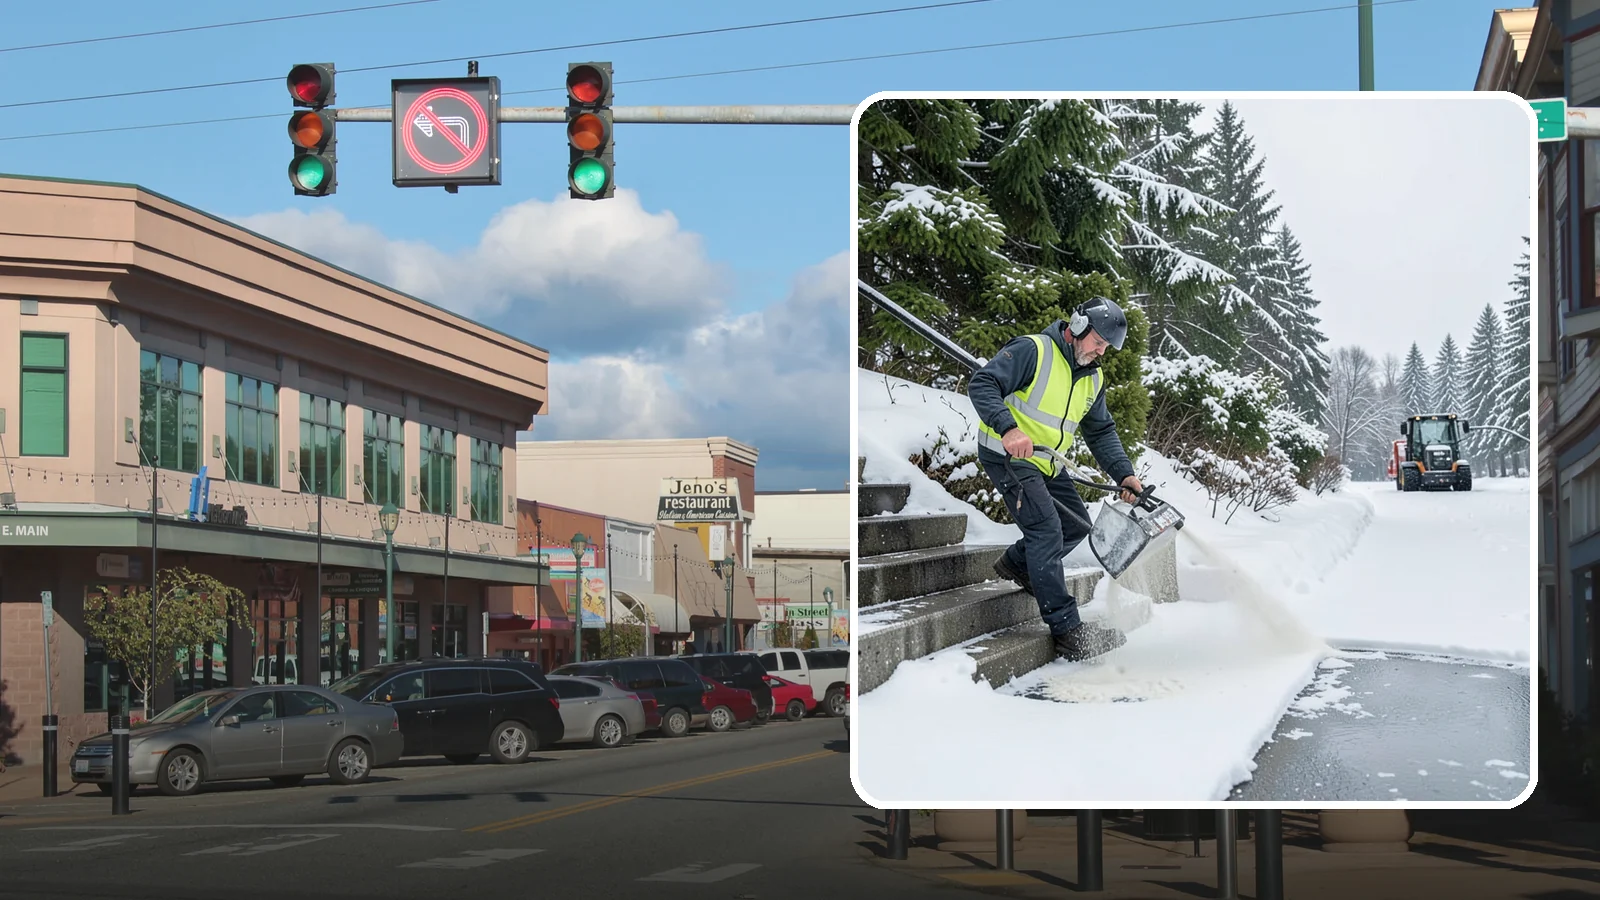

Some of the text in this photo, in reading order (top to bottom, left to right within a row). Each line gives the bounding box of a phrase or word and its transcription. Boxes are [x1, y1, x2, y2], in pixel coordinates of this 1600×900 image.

[670, 480, 727, 495] Jeno's
[665, 496, 731, 509] restaurant
[659, 510, 681, 520] Italian
[686, 509, 714, 519] American
[715, 510, 737, 519] Cuisine
[2, 525, 49, 536] E. MAIN
[797, 607, 828, 617] Street
